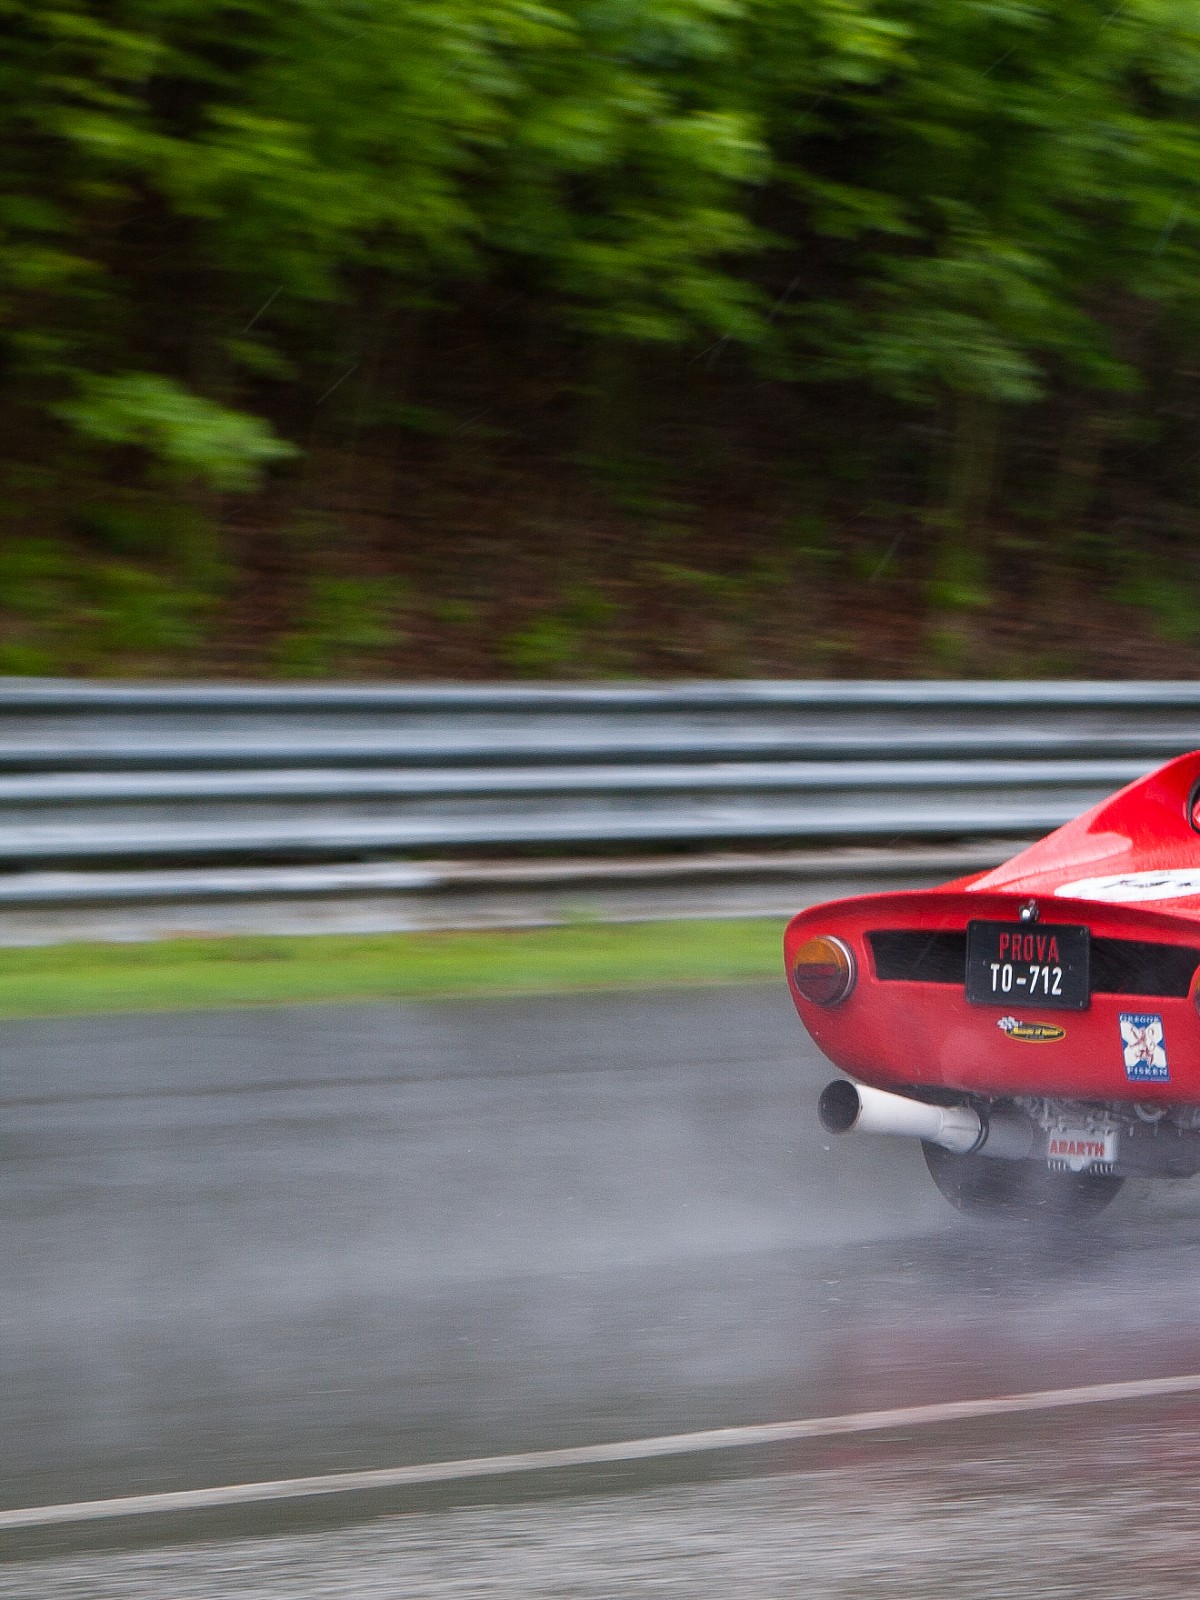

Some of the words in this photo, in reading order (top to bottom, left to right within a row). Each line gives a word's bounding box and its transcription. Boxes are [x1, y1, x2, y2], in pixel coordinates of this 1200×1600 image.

[998, 932, 1060, 964] PROVA
[990, 963, 1063, 996] TO-712
[1126, 1066, 1168, 1077] FISKEN
[1049, 1139, 1105, 1158] ABARTH
